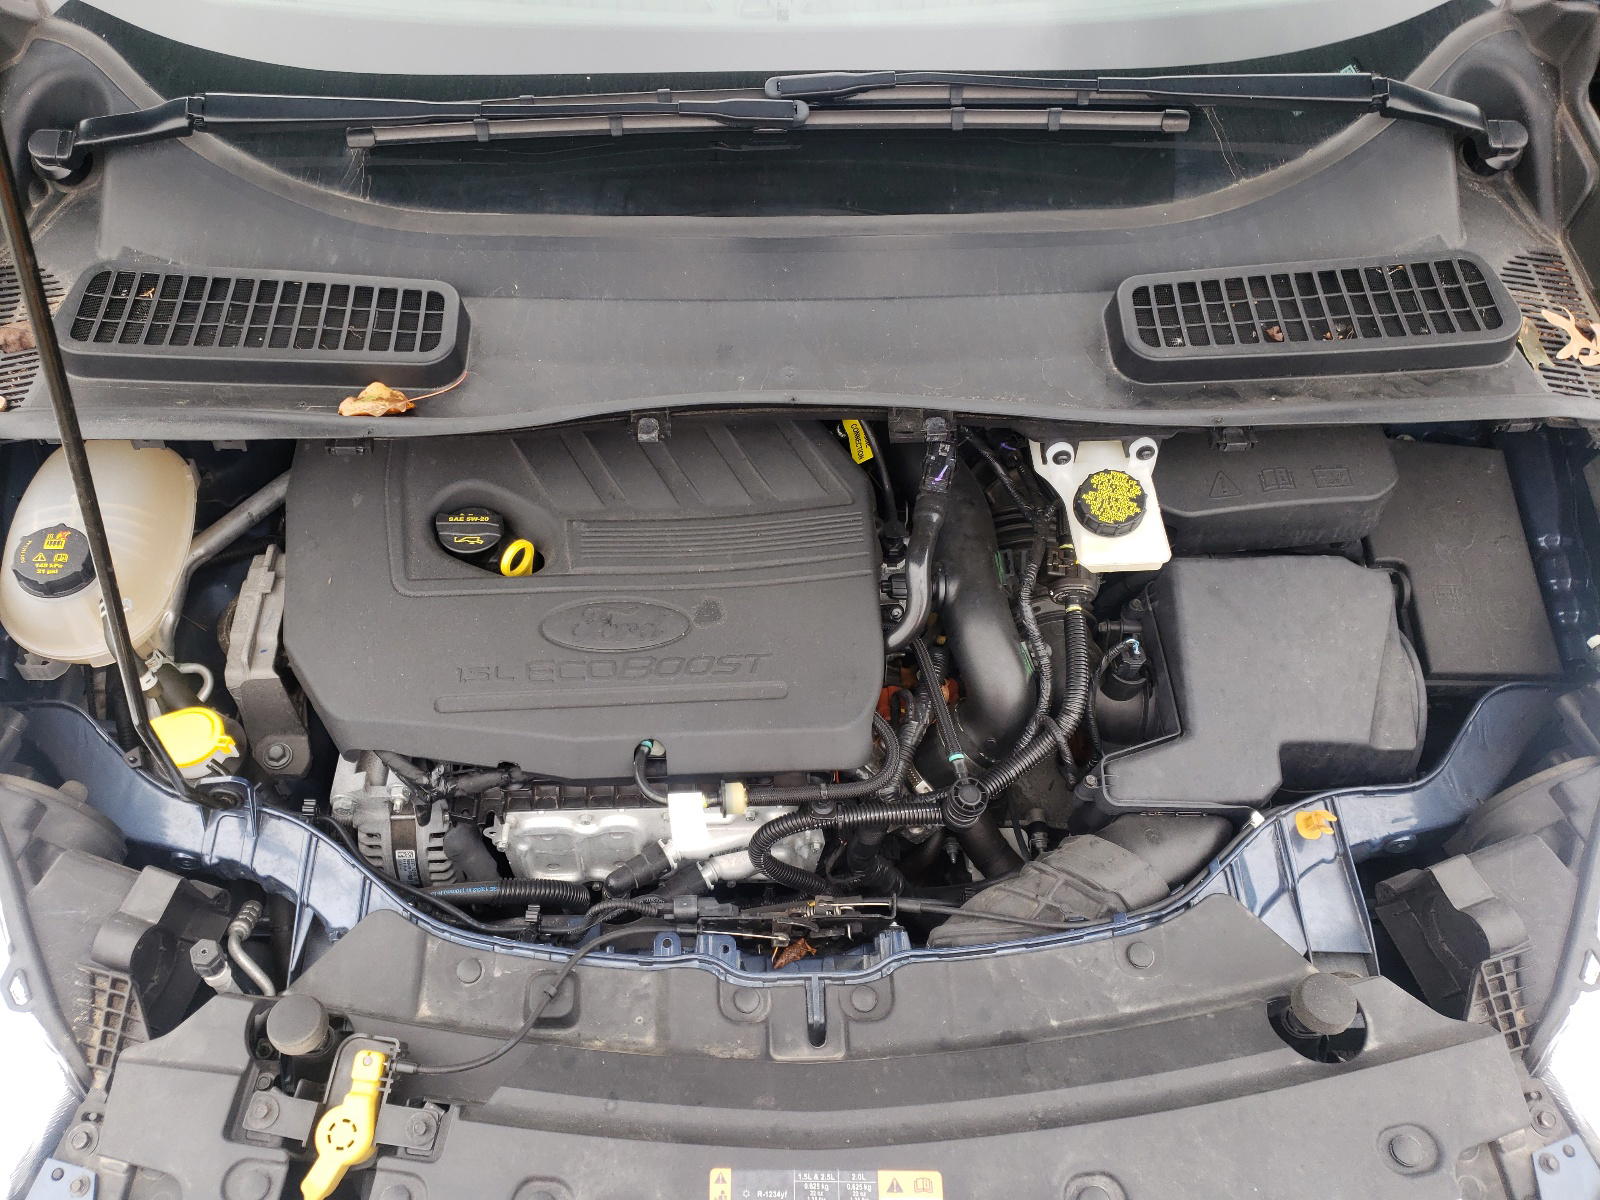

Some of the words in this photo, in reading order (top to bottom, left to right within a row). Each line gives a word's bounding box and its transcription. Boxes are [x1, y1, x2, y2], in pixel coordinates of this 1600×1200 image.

[851, 423, 865, 461] CONNECTION
[851, 1173, 867, 1181] 2.0L
[804, 1182, 820, 1190] 0.625
[821, 1182, 830, 1191] kg
[846, 1183, 863, 1191] 0.625
[863, 1183, 872, 1193] kg
[757, 1190, 788, 1199] R-1234yf
